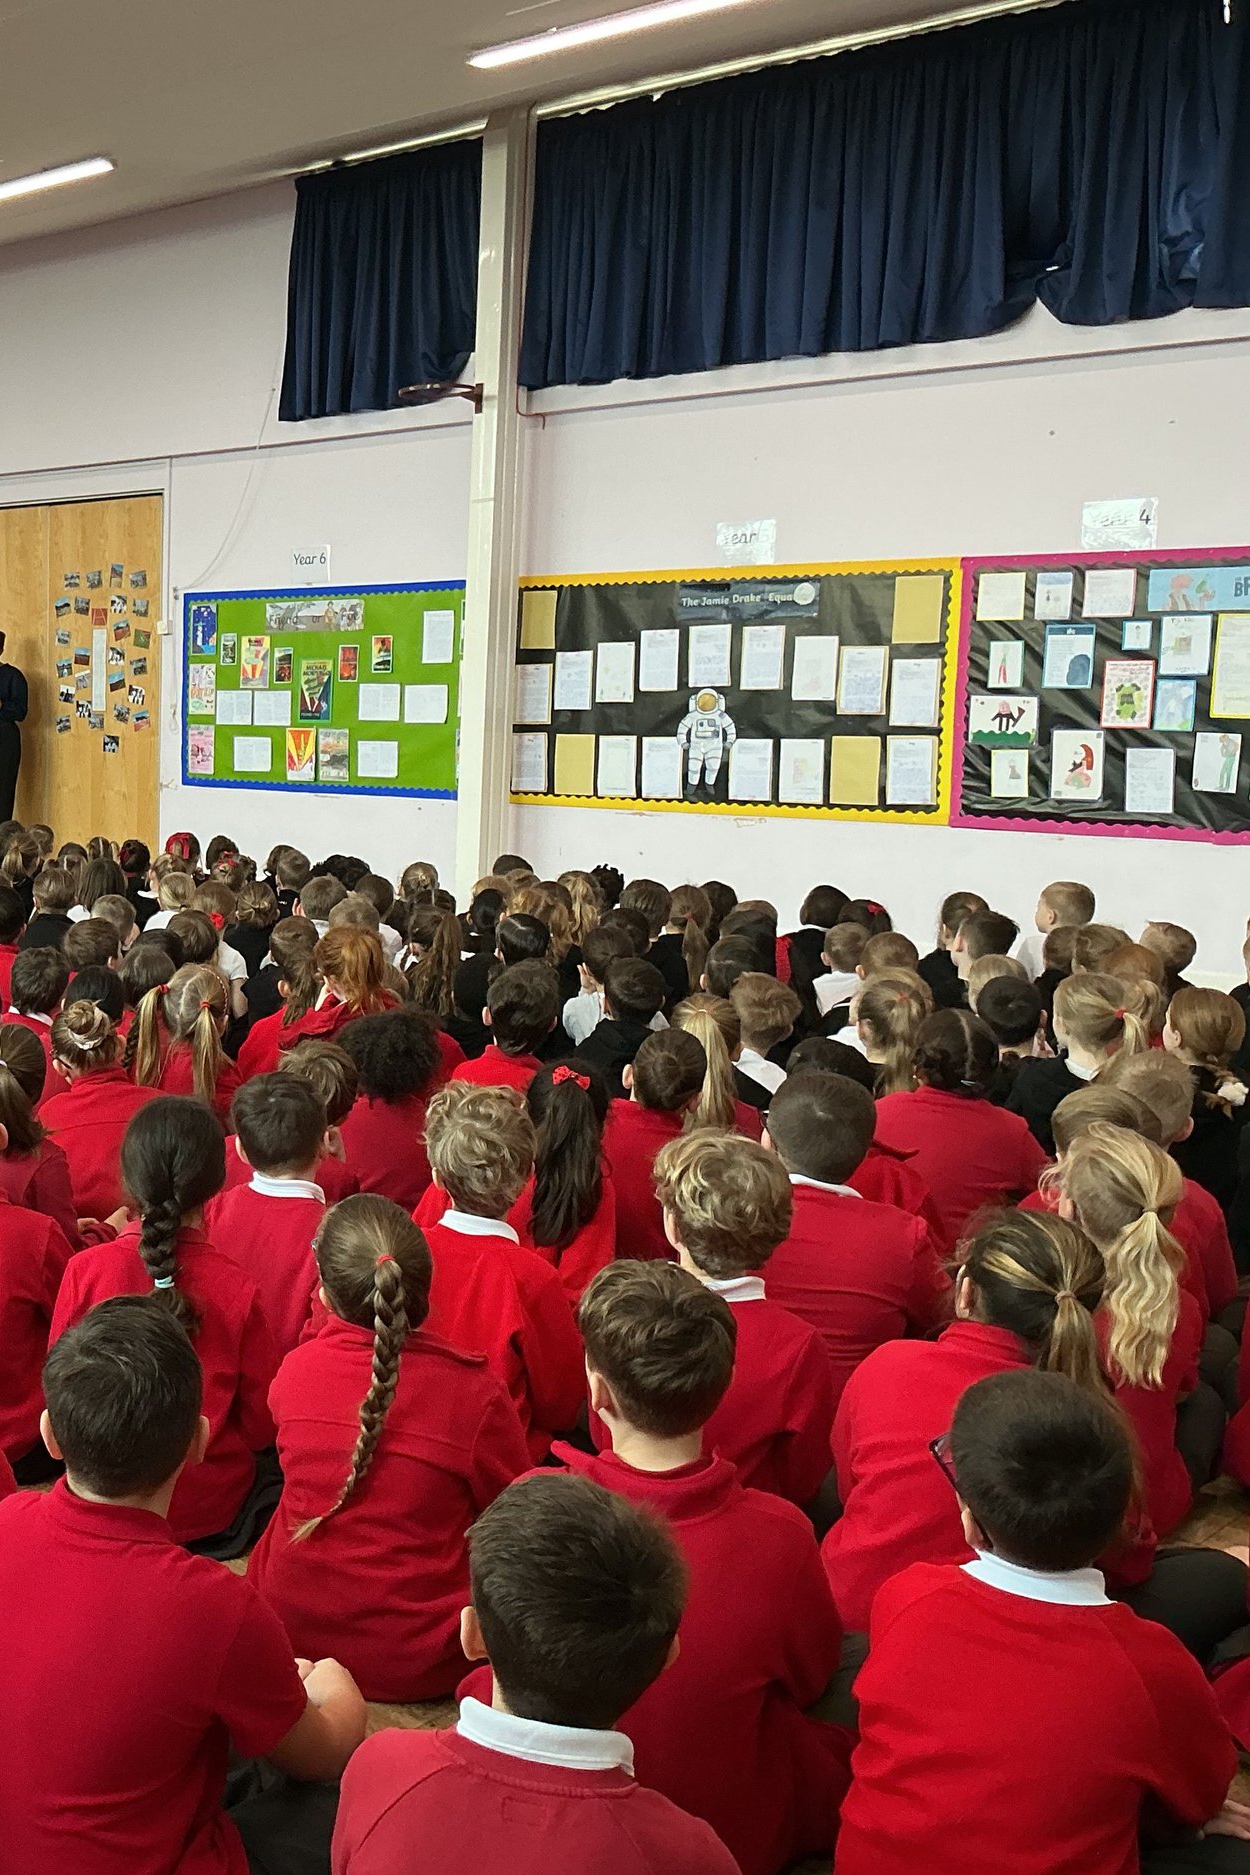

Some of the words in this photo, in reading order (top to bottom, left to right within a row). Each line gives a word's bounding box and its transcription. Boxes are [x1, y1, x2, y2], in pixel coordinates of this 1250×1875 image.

[1139, 508, 1151, 525] 4
[293, 553, 317, 565] Year
[319, 552, 326, 565] 6
[682, 598, 699, 607] The
[700, 595, 730, 606] Jamie
[732, 593, 761, 603] Drake
[768, 592, 794, 605] Equa
[311, 615, 322, 624] or
